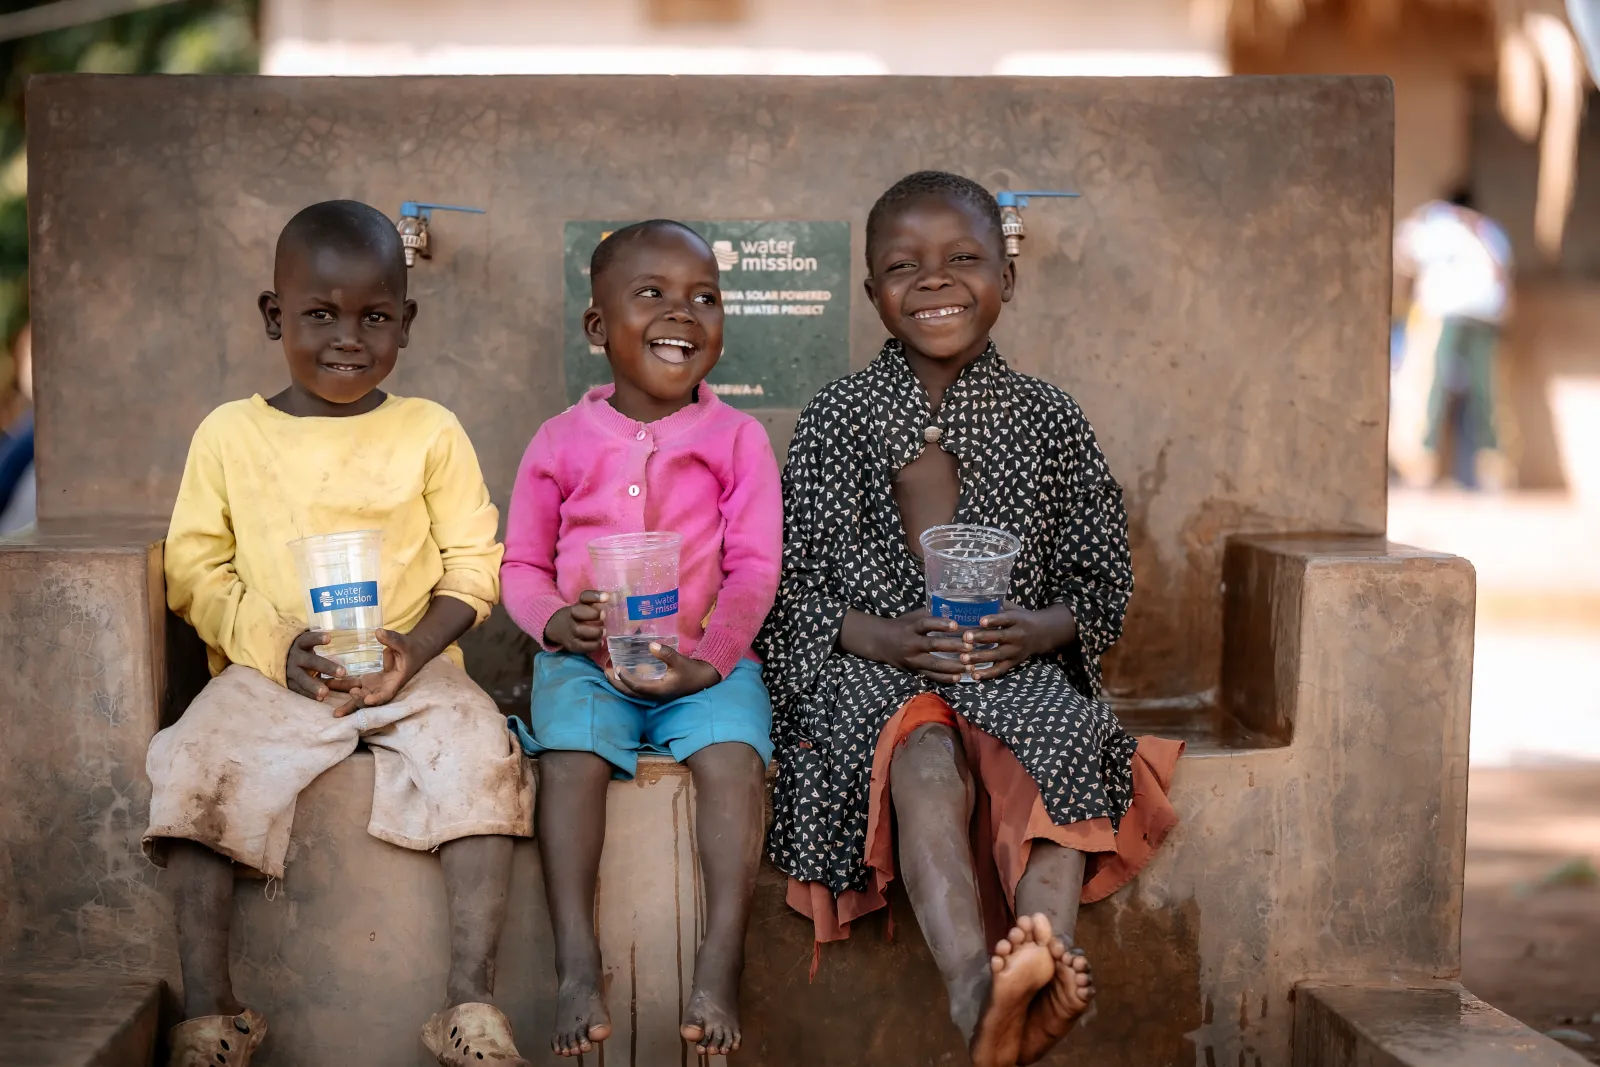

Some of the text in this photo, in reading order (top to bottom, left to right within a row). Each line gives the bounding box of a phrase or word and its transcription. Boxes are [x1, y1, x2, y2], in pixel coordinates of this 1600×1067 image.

[740, 238, 796, 254] water
[741, 254, 818, 271] mission
[745, 290, 778, 301] SOLAR
[780, 290, 832, 301] POWERED
[723, 304, 825, 315] AFE WATER PROJECT
[334, 586, 362, 597] water
[336, 594, 371, 606] mission
[654, 594, 676, 606] water
[655, 603, 679, 615] missio
[953, 606, 983, 614] water
[954, 613, 980, 623] missi
